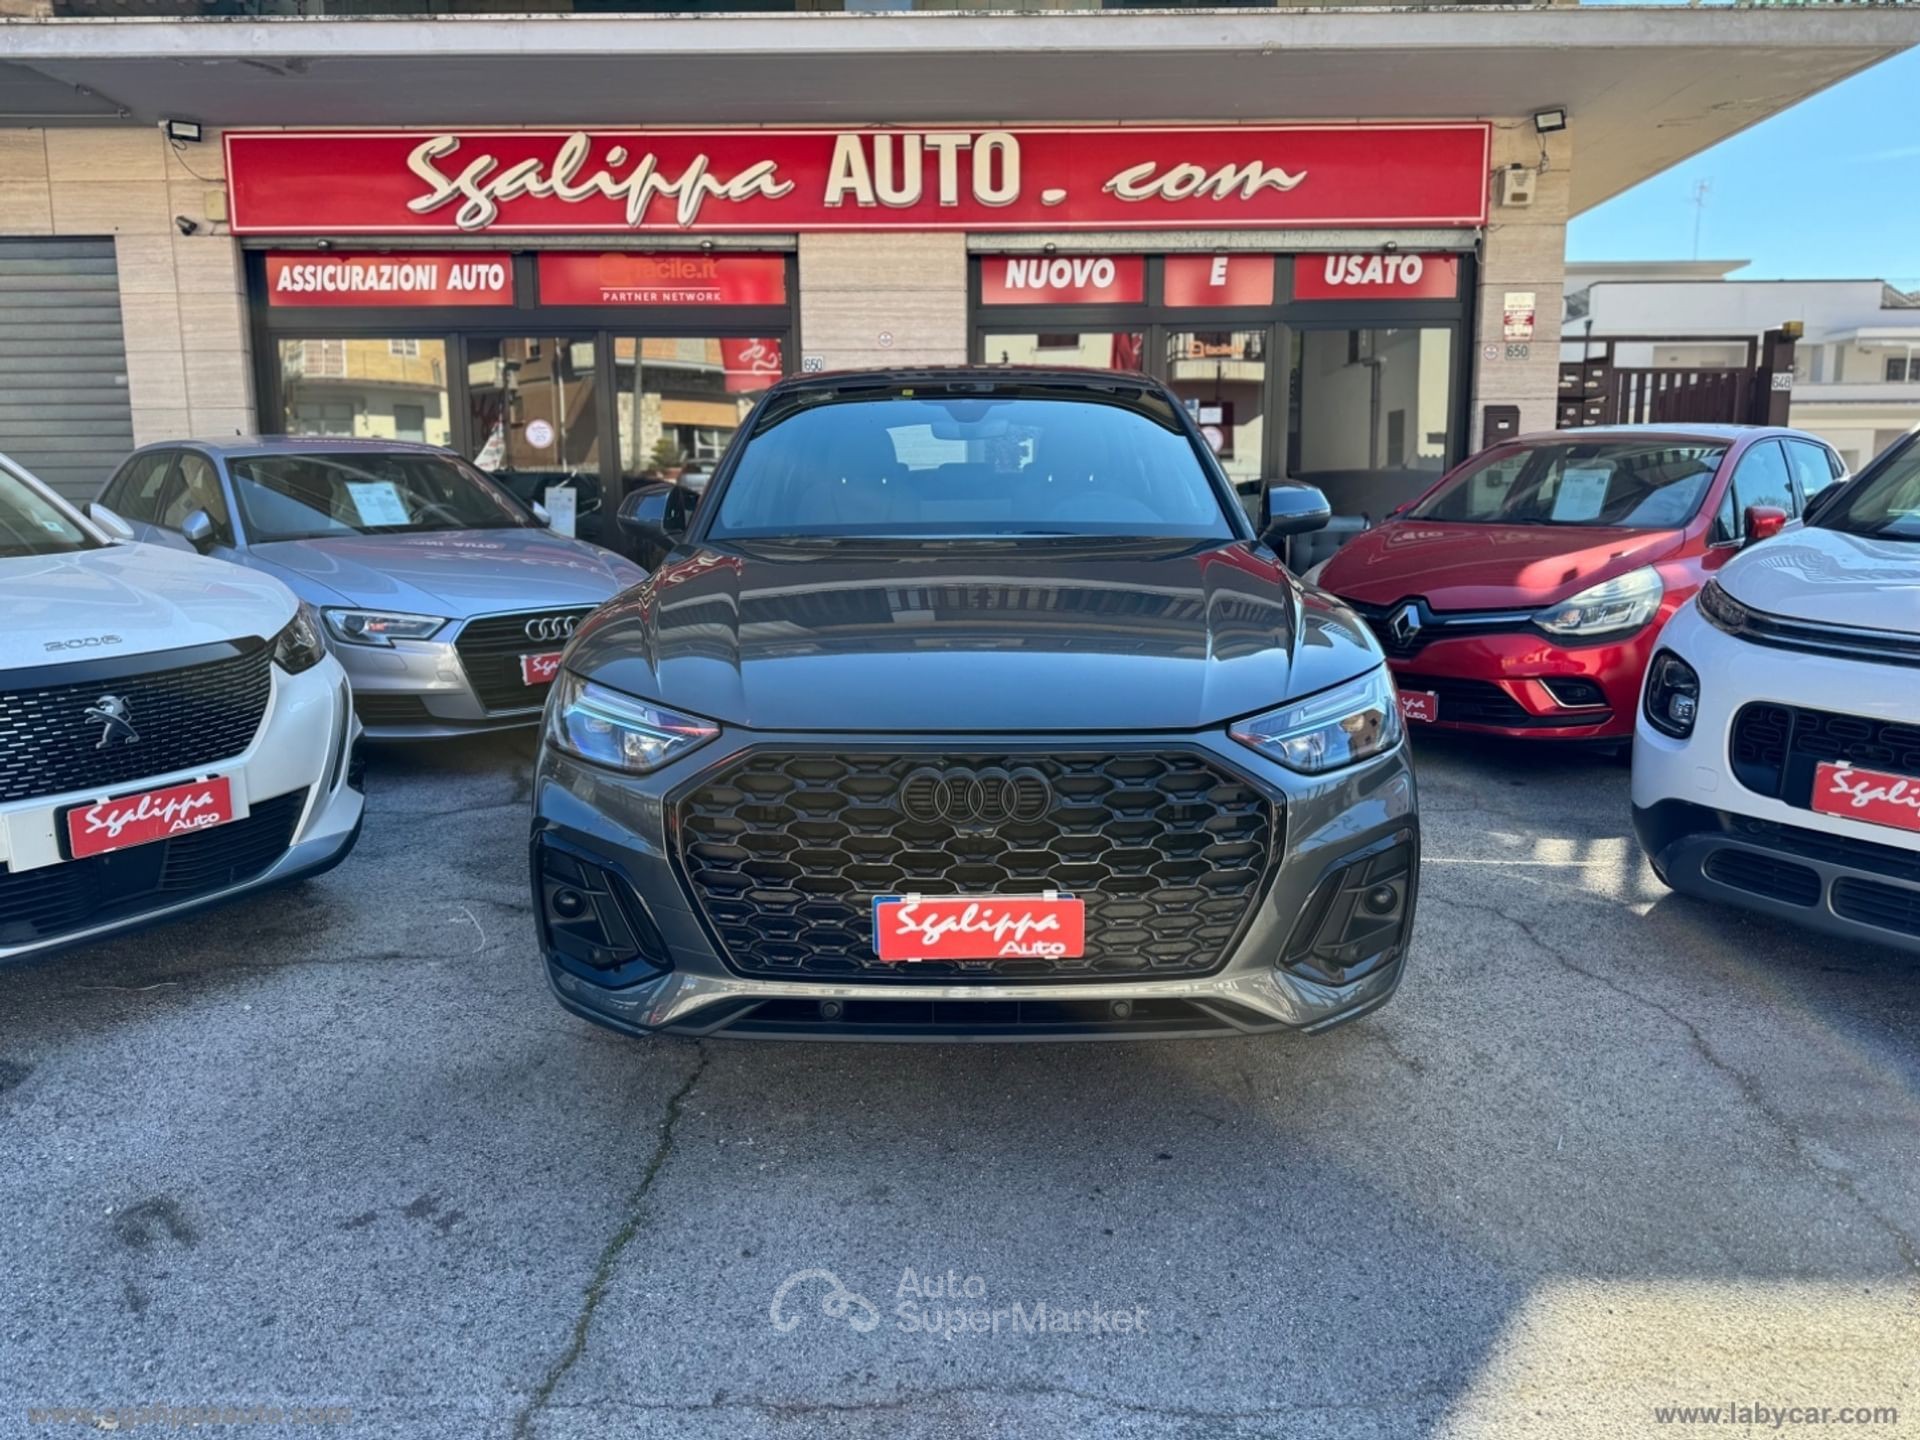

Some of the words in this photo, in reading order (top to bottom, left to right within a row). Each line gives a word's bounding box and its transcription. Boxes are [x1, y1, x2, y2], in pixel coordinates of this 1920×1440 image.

[406, 131, 795, 230] Sgalippa
[823, 131, 1021, 207] AUTO
[276, 265, 437, 292] ASSICURAZIONI
[446, 264, 505, 290] AUTO
[1005, 259, 1115, 289] NUOVO
[1209, 259, 1229, 286] E
[1323, 255, 1424, 285] USATO
[603, 292, 658, 302] PARTNER
[662, 292, 721, 302] NETWORK
[804, 358, 823, 371] 650
[1506, 344, 1529, 358] 650
[85, 791, 214, 838] Sgalippa
[169, 812, 220, 833] Auto
[895, 903, 1060, 945] Sgalippa
[998, 940, 1066, 956] Auto
